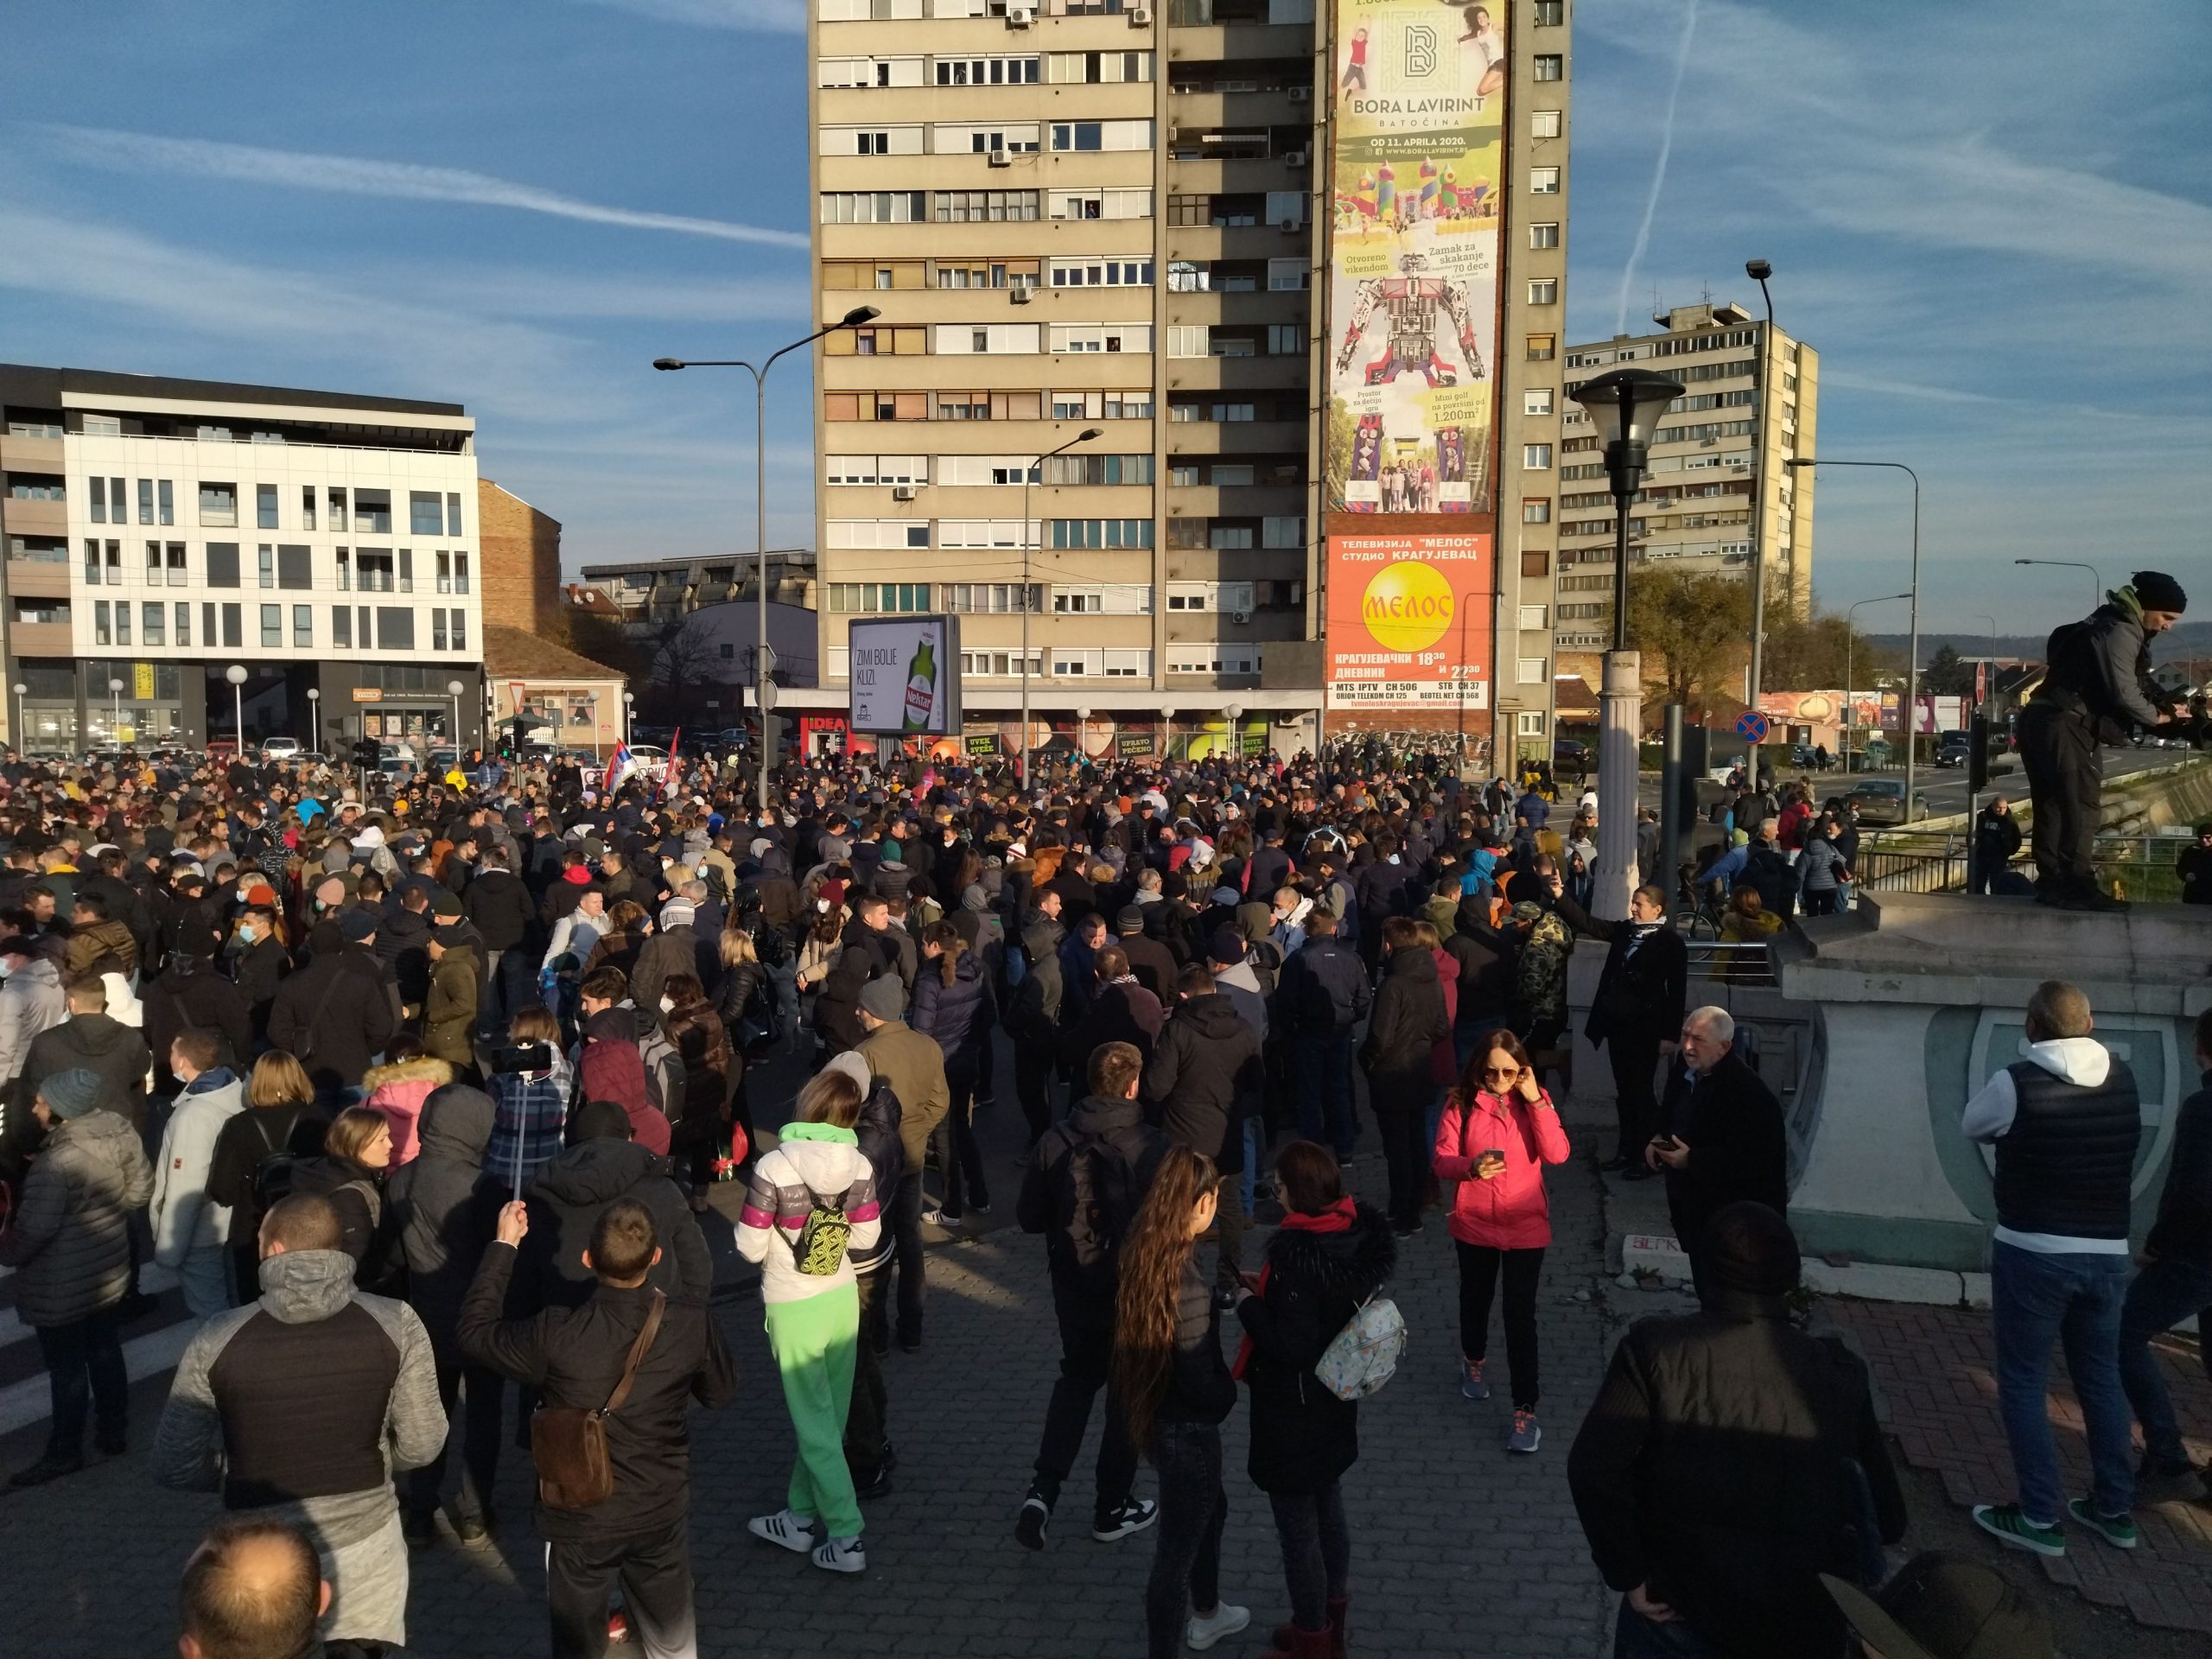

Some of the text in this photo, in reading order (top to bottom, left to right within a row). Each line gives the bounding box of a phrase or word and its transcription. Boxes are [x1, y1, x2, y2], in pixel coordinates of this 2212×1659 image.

[1354, 98, 1484, 114] BORA LAVIRINT
[1379, 117, 1459, 127] BATOČINA
[1370, 137, 1466, 147] OD 11. APRILA 2020.
[1429, 244, 1476, 257] Zamak za
[1346, 253, 1387, 264] Otvoreno
[1440, 250, 1484, 264] skakanje
[1344, 264, 1389, 274] vikendom
[1453, 264, 1465, 273] 70
[1467, 261, 1489, 271] dece
[1435, 391, 1469, 402] Mini golf
[1365, 405, 1379, 413] igru
[1342, 540, 1412, 549] ТЕЛЕВИЗИЈА
[1342, 550, 1477, 562] СТУДИО КРАГУЈЕВАЦ
[857, 648, 898, 666] ZIMI BOLJE
[1335, 653, 1412, 664] КРАГУЈЕВАЧКИ
[857, 669, 877, 686] KLIZI.
[1335, 667, 1386, 680] ДНЕВНИК
[1336, 683, 1417, 691] MTS IPTV CH 506
[1438, 682, 1479, 690] STB CH 37
[906, 689, 931, 709] Nektar
[969, 737, 991, 746] UVEK
[1121, 738, 1150, 747] UPRAVO
[969, 744, 995, 753] SVEŽE
[1122, 745, 1152, 754] PEČENO
